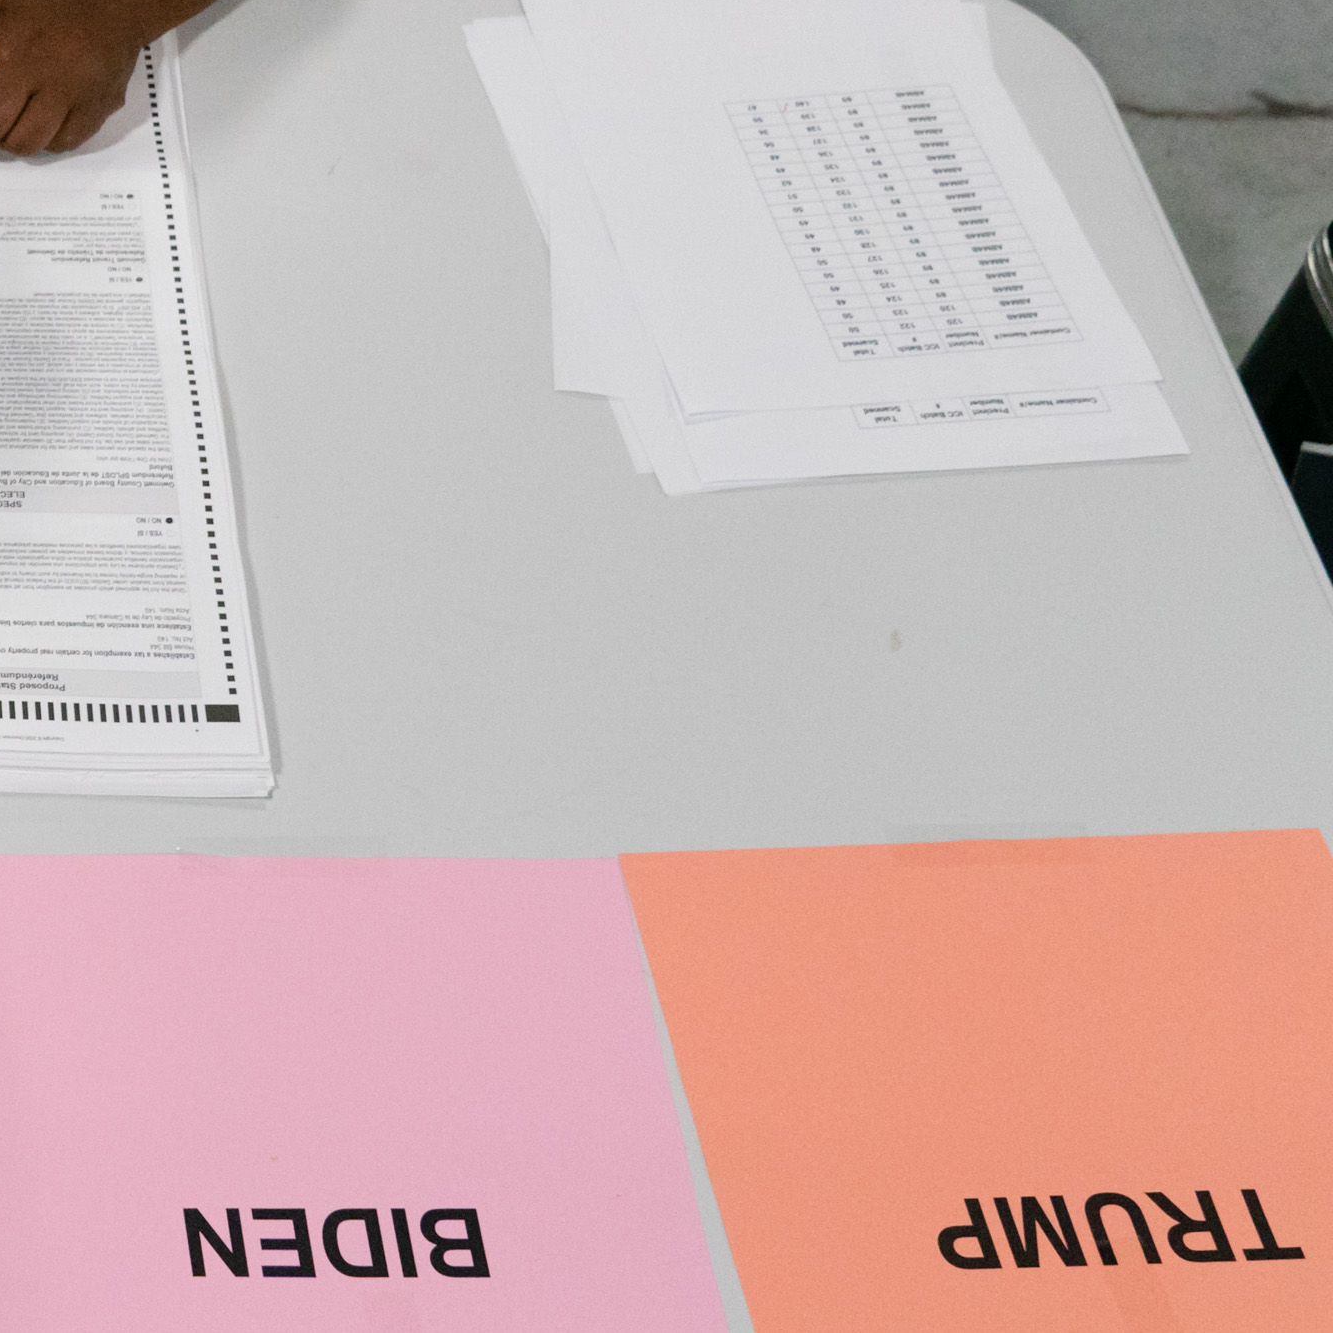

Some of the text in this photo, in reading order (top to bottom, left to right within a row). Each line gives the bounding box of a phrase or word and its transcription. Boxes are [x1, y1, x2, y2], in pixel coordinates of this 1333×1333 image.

[18, 478, 32, 486] City
[49, 479, 83, 487] Education
[117, 479, 142, 488] County
[153, 652, 195, 660] Establishes
[0, 672, 59, 684] Referéndum
[19, 682, 66, 692] Proposed
[937, 1189, 1305, 1270] TRUMP
[183, 1208, 490, 1278] BIDEN
